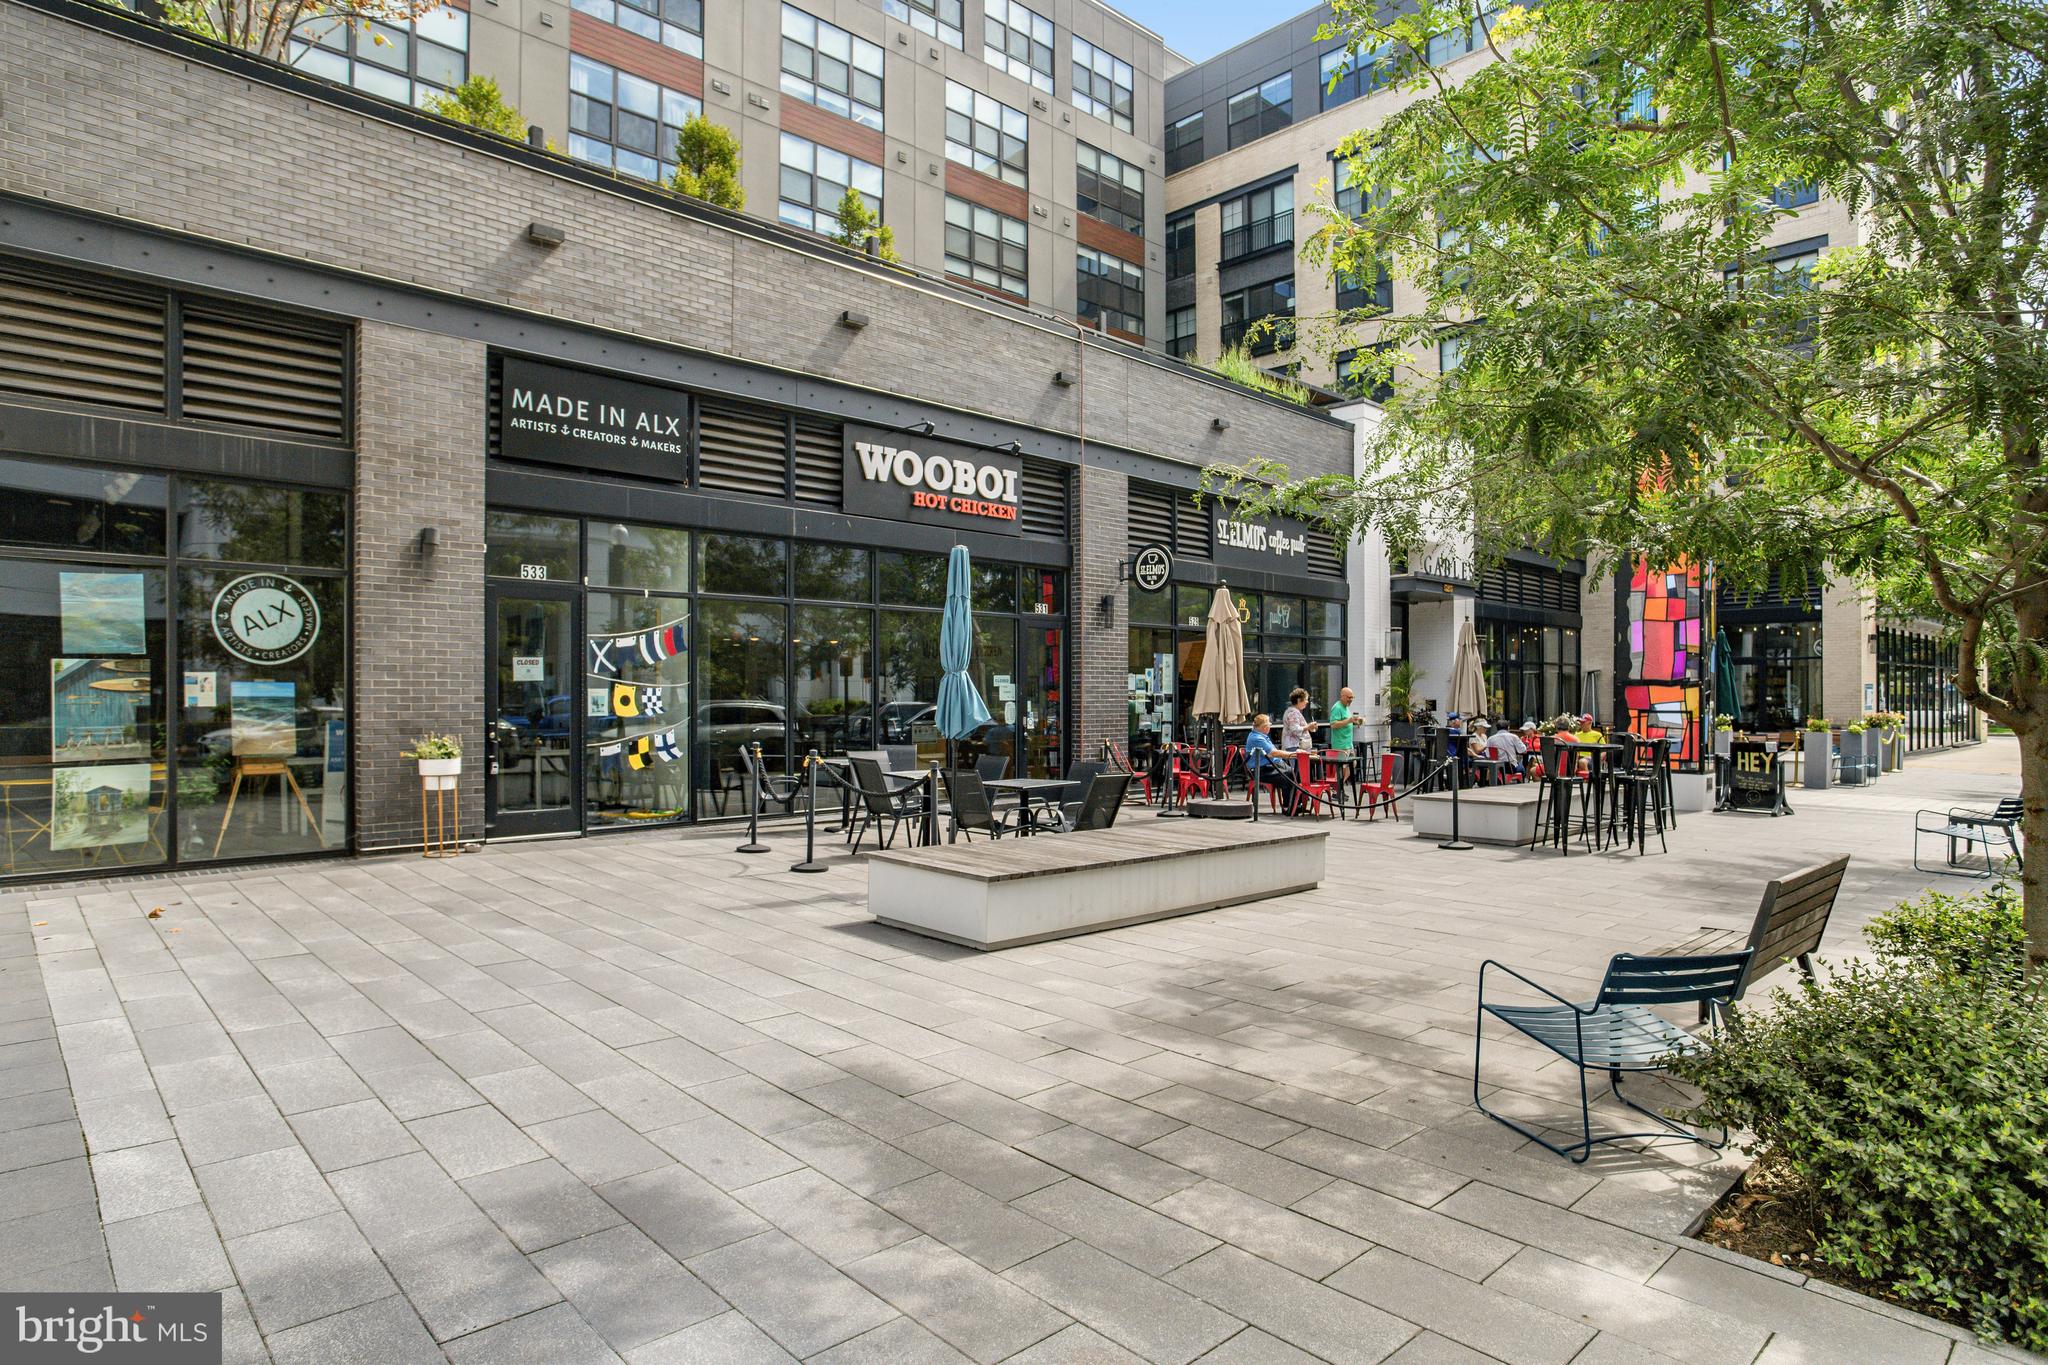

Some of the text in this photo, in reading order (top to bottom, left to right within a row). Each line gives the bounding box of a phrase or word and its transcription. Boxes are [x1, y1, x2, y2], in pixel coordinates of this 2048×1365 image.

[511, 388, 680, 437] MADE IN ALX
[510, 417, 682, 454] ARTISTS CREATORS MAKERS
[855, 441, 1018, 503] WOOBOI
[913, 490, 1017, 520] HOT CHICKEN
[521, 565, 546, 580] 533
[224, 578, 275, 605] MADE IN
[1035, 603, 1047, 613] 531
[222, 596, 313, 659] ARTISTS CREATORS MAKERS
[243, 599, 296, 636] ALX
[1737, 751, 1774, 775] HEY
